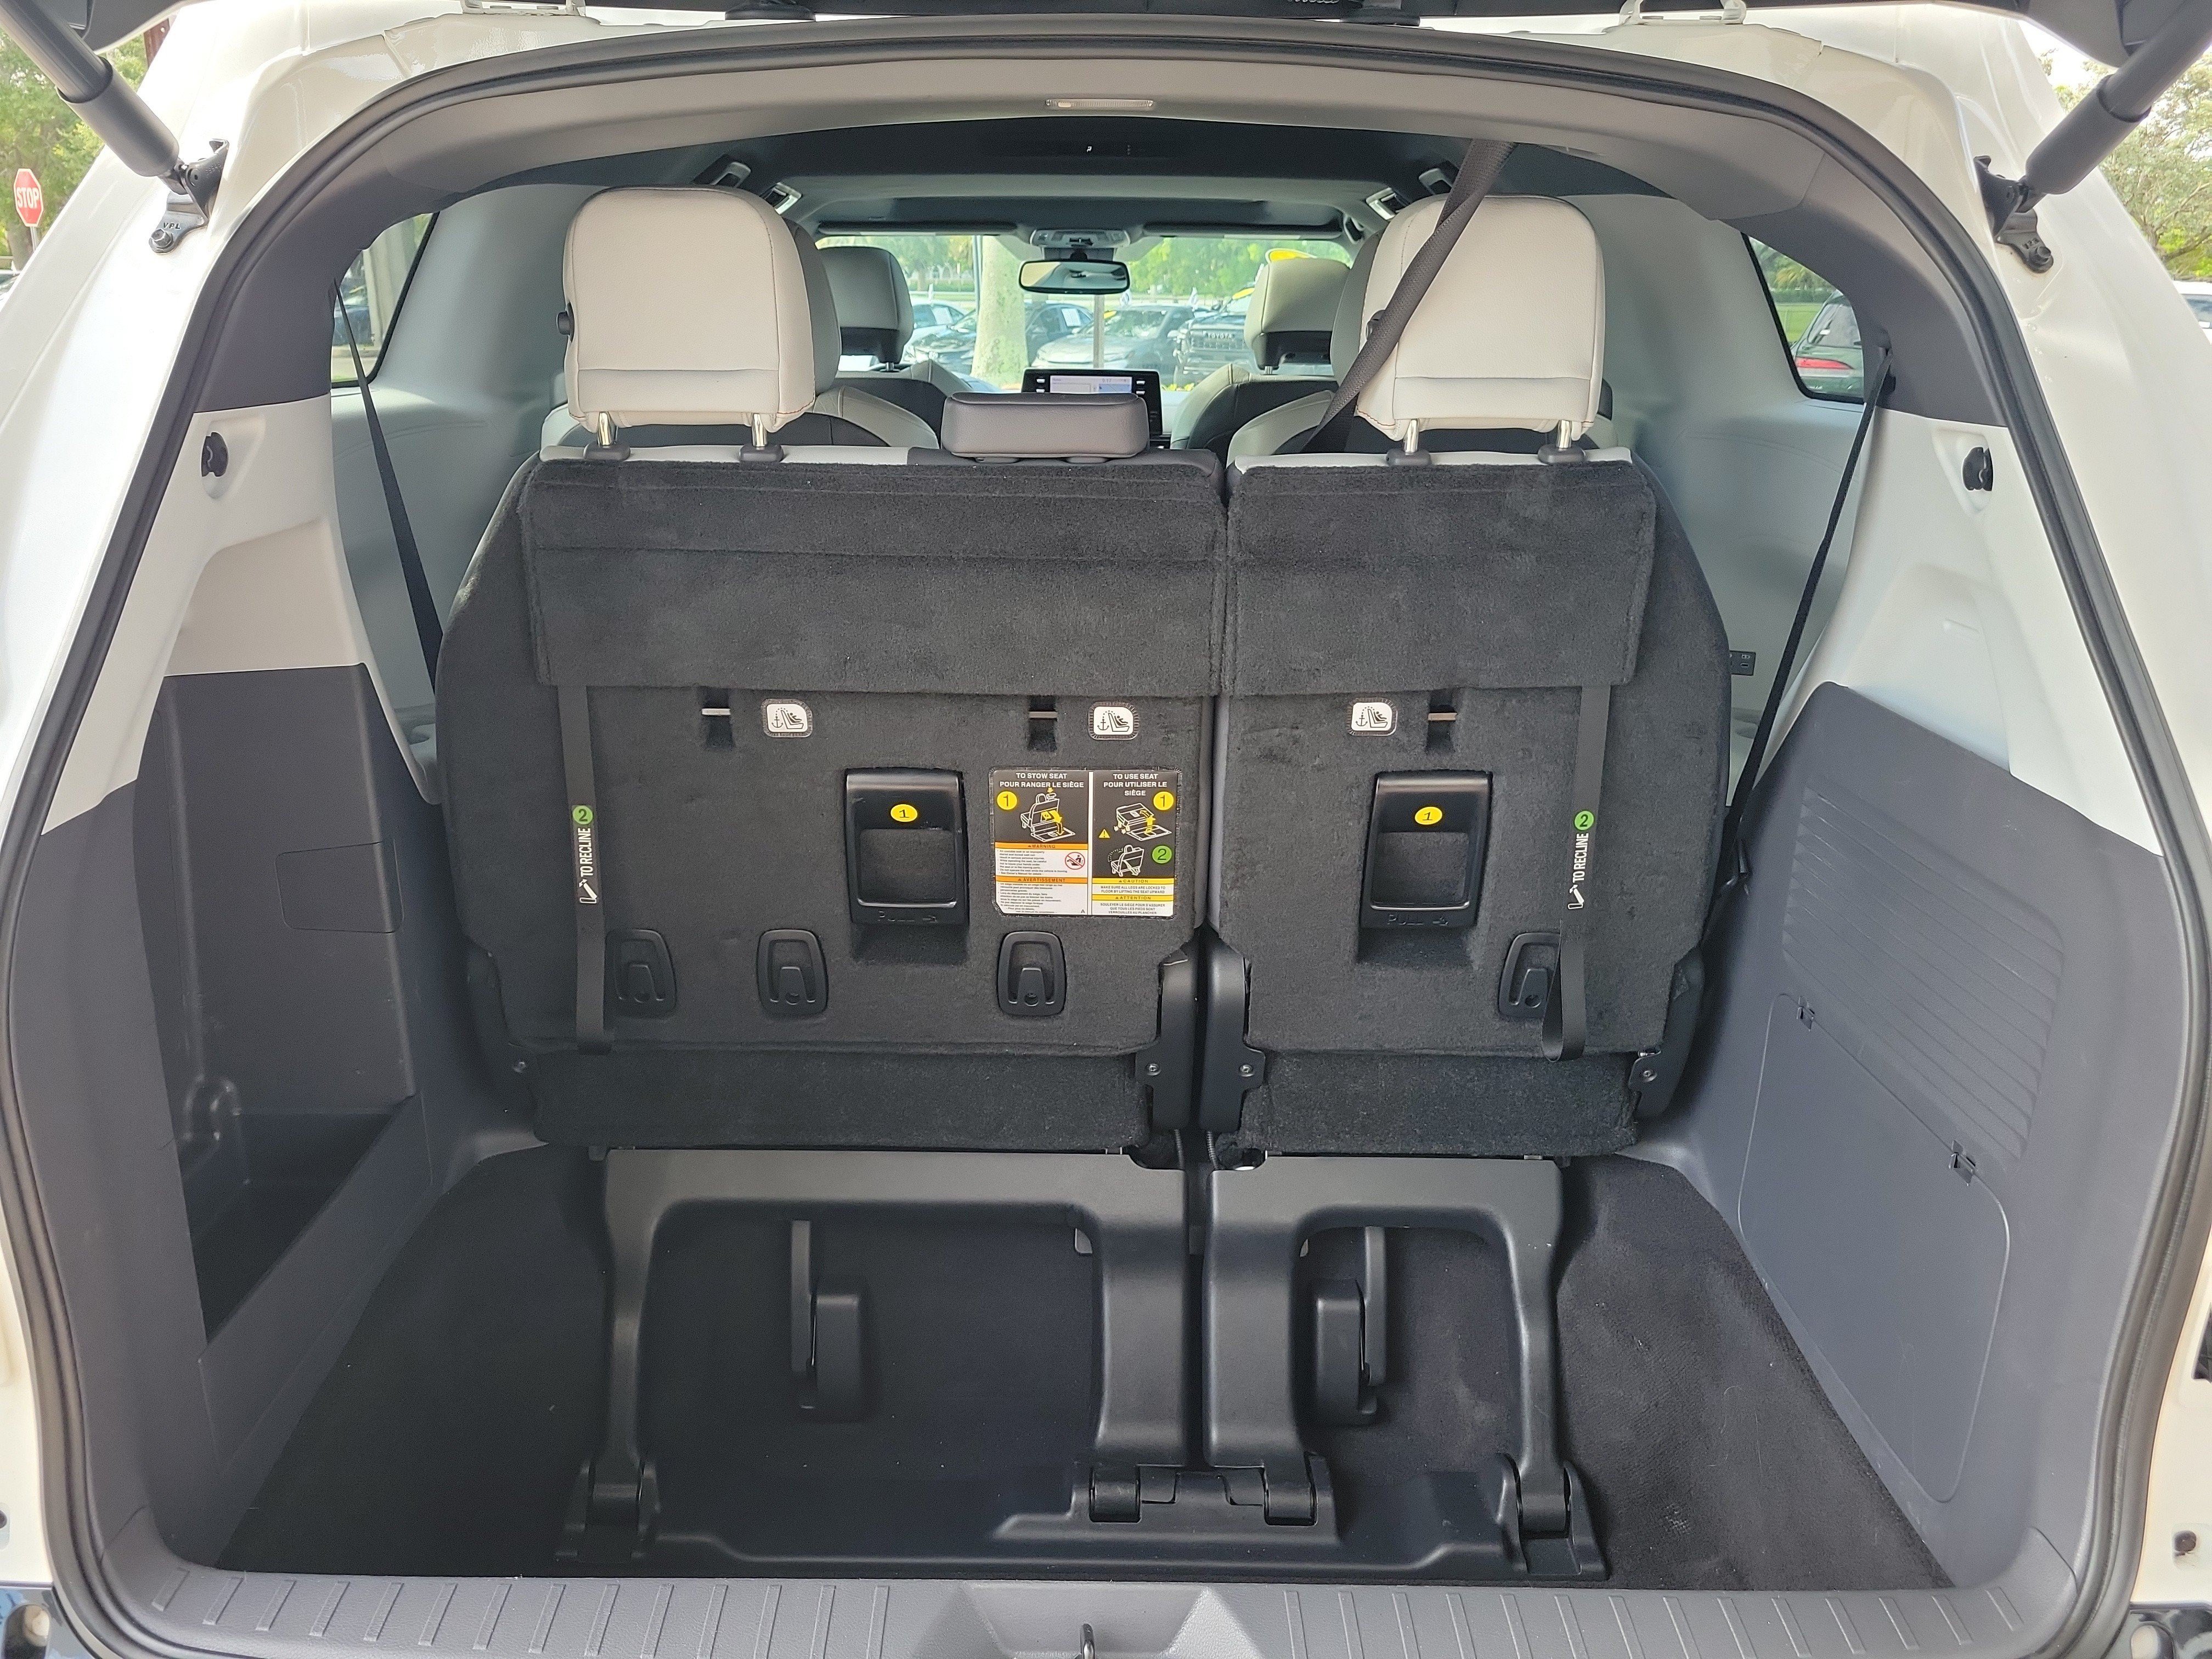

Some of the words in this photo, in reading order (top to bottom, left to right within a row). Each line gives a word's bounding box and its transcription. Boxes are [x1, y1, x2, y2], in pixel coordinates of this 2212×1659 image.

[16, 187, 40, 208] STOP
[1003, 794, 1008, 807] 1
[1160, 795, 1165, 807] 1
[578, 809, 588, 822] 2
[899, 809, 910, 818] 1
[1422, 811, 1433, 821] 1
[1579, 814, 1589, 827] 2
[578, 827, 592, 864] RECLINE
[1573, 833, 1589, 870] RECLINE
[1158, 848, 1167, 860] 2
[580, 866, 593, 877] TO
[1572, 871, 1585, 883] TO
